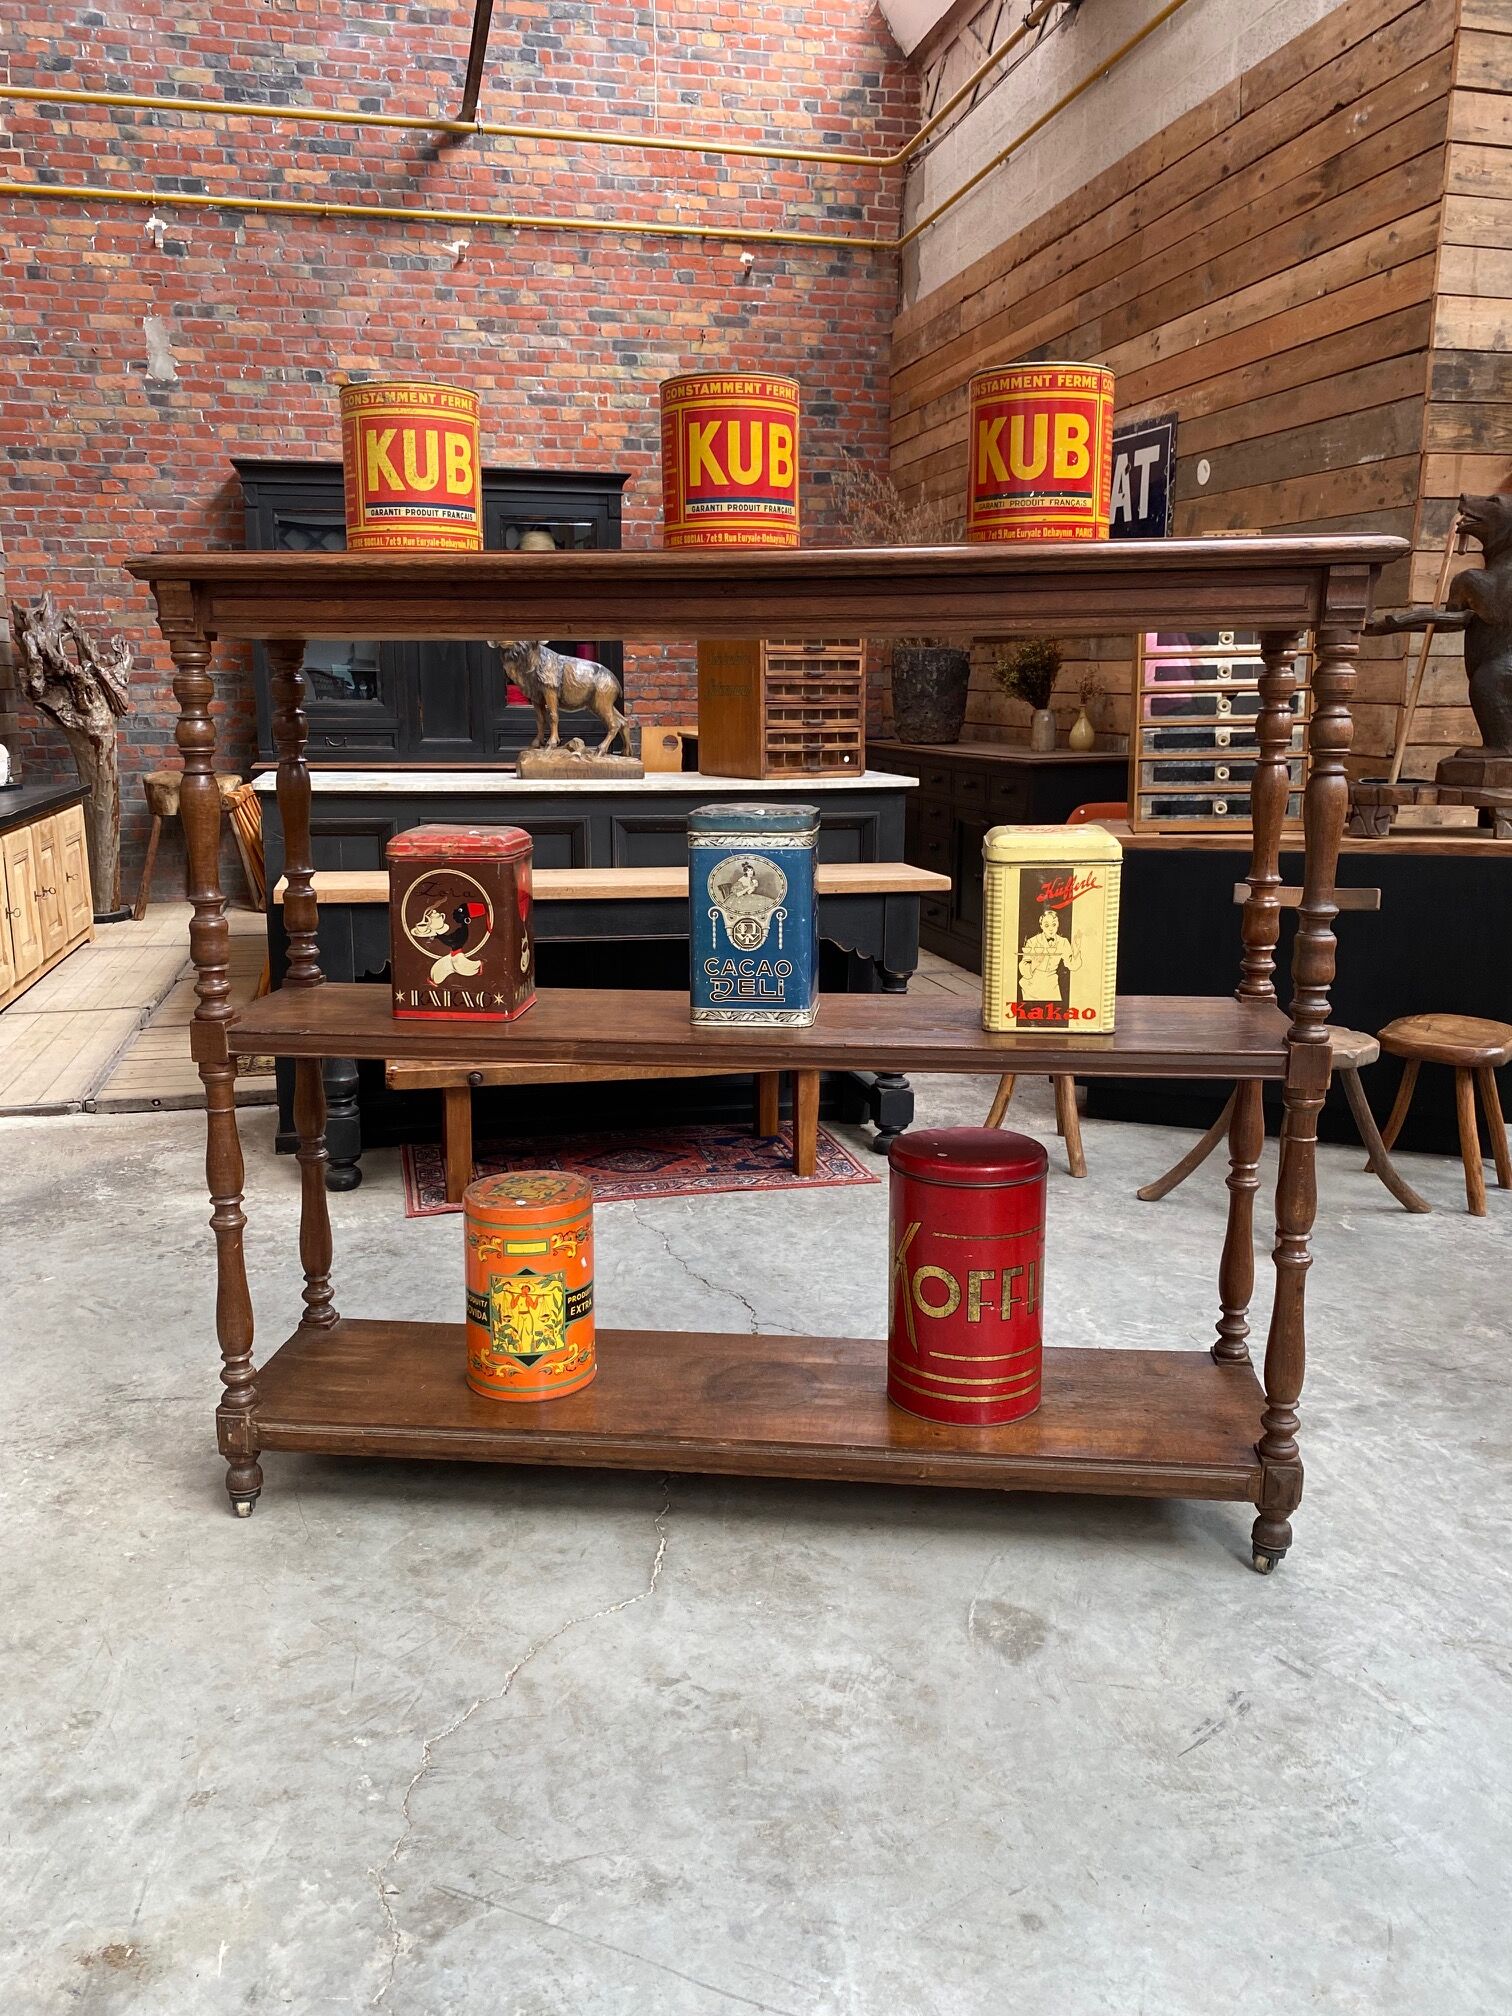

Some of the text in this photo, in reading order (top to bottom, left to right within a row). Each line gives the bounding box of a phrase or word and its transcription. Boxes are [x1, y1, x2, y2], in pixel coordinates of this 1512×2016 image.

[665, 381, 762, 400] CONSTAMMENT
[971, 374, 1098, 397] ONSTAMMENT FERME
[343, 391, 437, 408] CONSTAMMENT
[688, 420, 794, 488] KUB
[978, 413, 1090, 485] KUB
[366, 428, 474, 495] KUB
[691, 504, 792, 515] GARANTI PRODUIT FRANÇAIS
[978, 499, 1087, 510] GARANTI PRODUIT FRANÇAIS
[370, 508, 473, 521] GARANTI PRODUIT FRANÇAIS
[389, 536, 396, 546] et
[402, 536, 416, 547] Rue
[710, 533, 718, 542] et
[724, 533, 737, 543] Rue
[1016, 527, 1042, 540] Euryale
[1075, 527, 1093, 538] PARIS
[413, 882, 479, 898] Zora
[1036, 871, 1103, 907] Küfferle
[704, 958, 793, 977] CACAO
[410, 989, 494, 1008] KAKAO
[1005, 1001, 1097, 1020] Kakao
[889, 1221, 1045, 1353] KOFFI
